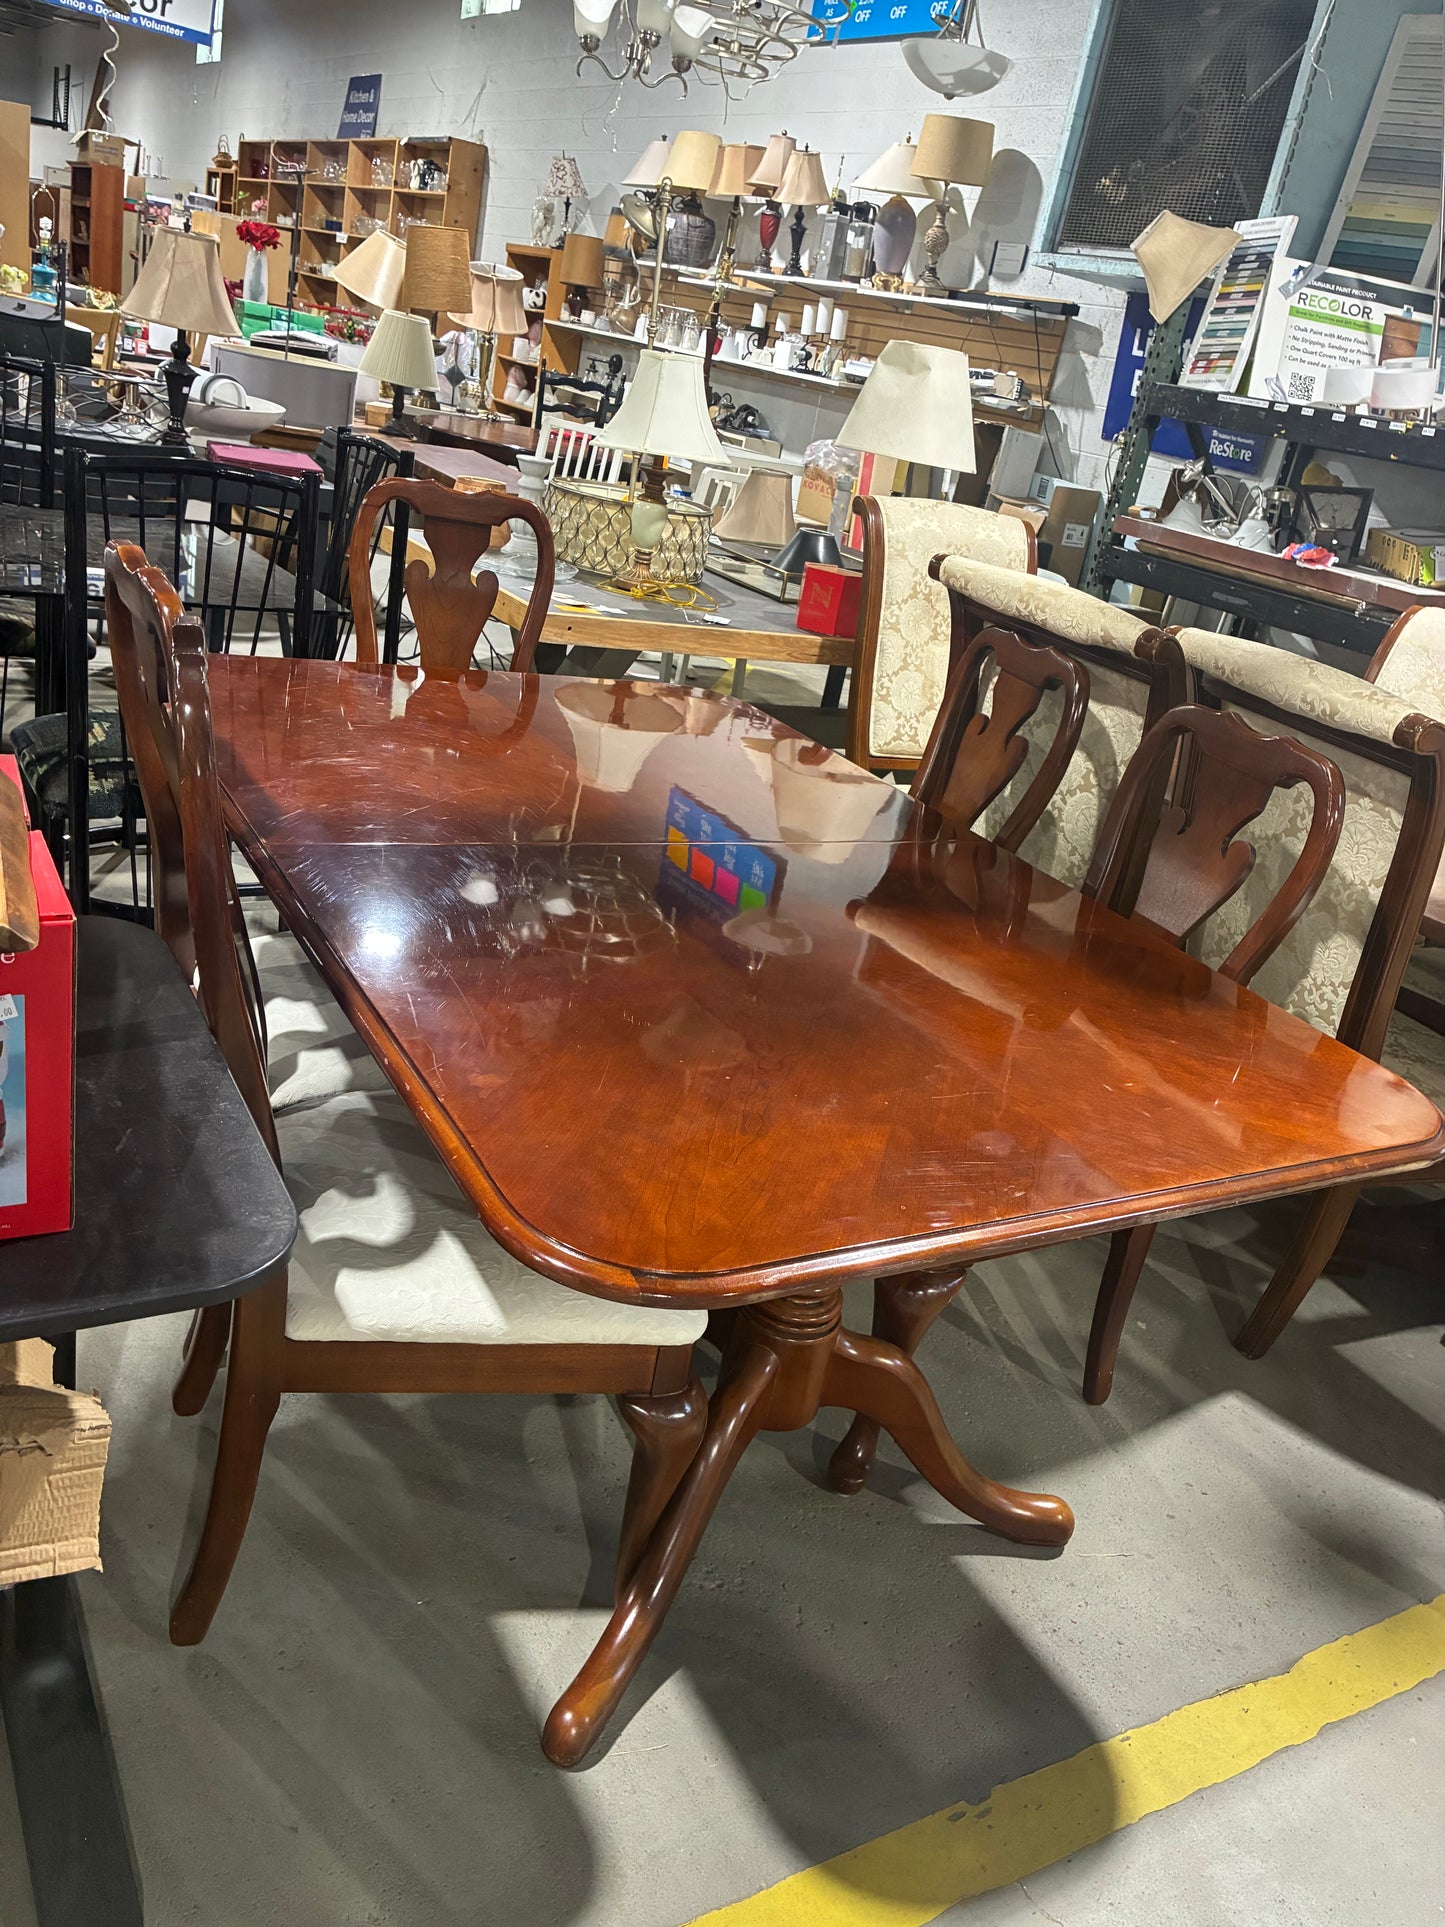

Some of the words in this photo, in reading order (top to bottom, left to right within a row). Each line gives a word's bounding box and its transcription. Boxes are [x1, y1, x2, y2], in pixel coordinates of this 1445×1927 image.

[890, 5, 908, 20] OFF
[930, 1, 949, 17] OFF
[855, 10, 871, 23] OFF
[140, 16, 185, 37] Volunteer
[1335, 285, 1351, 295] PAINT
[1351, 288, 1377, 299] PRODUCT
[1294, 324, 1308, 334] Chalk
[1309, 328, 1323, 337] Paint
[1324, 331, 1336, 339] with
[1336, 334, 1352, 343] Matte
[1353, 338, 1369, 346] Finish
[1302, 347, 1318, 357] Quart
[1318, 351, 1337, 361] Covers
[1327, 343, 1348, 354] Sanding
[1288, 354, 1299, 362] Can
[1208, 438, 1252, 462] ReStore
